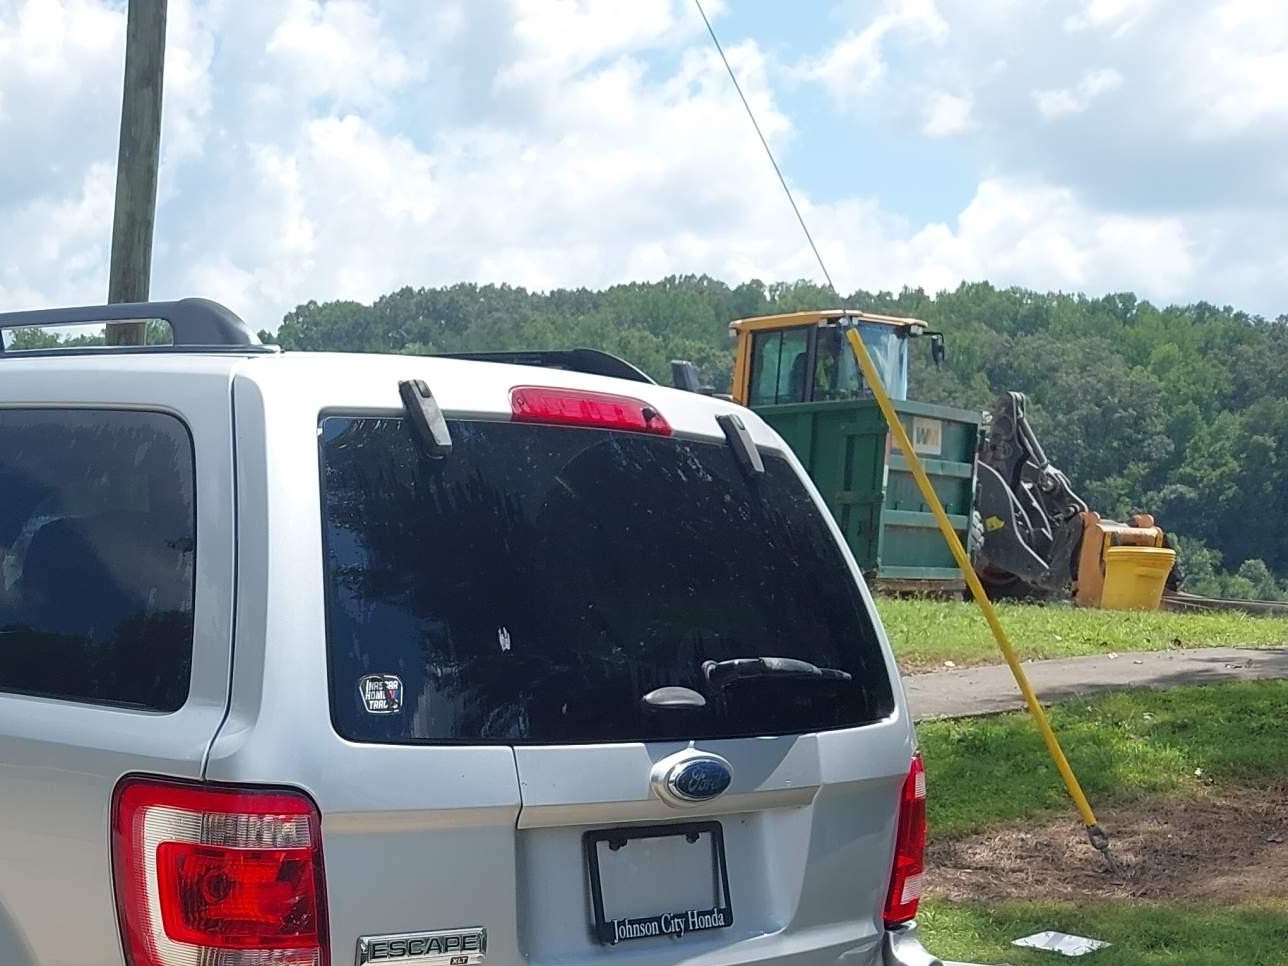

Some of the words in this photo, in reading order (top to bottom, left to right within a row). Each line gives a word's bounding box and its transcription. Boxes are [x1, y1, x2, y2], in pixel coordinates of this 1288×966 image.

[613, 918, 660, 944] Johnson
[661, 912, 686, 937] City
[687, 907, 725, 931] Honda
[372, 934, 480, 959] ESCAPE
[451, 957, 468, 965] XLT
